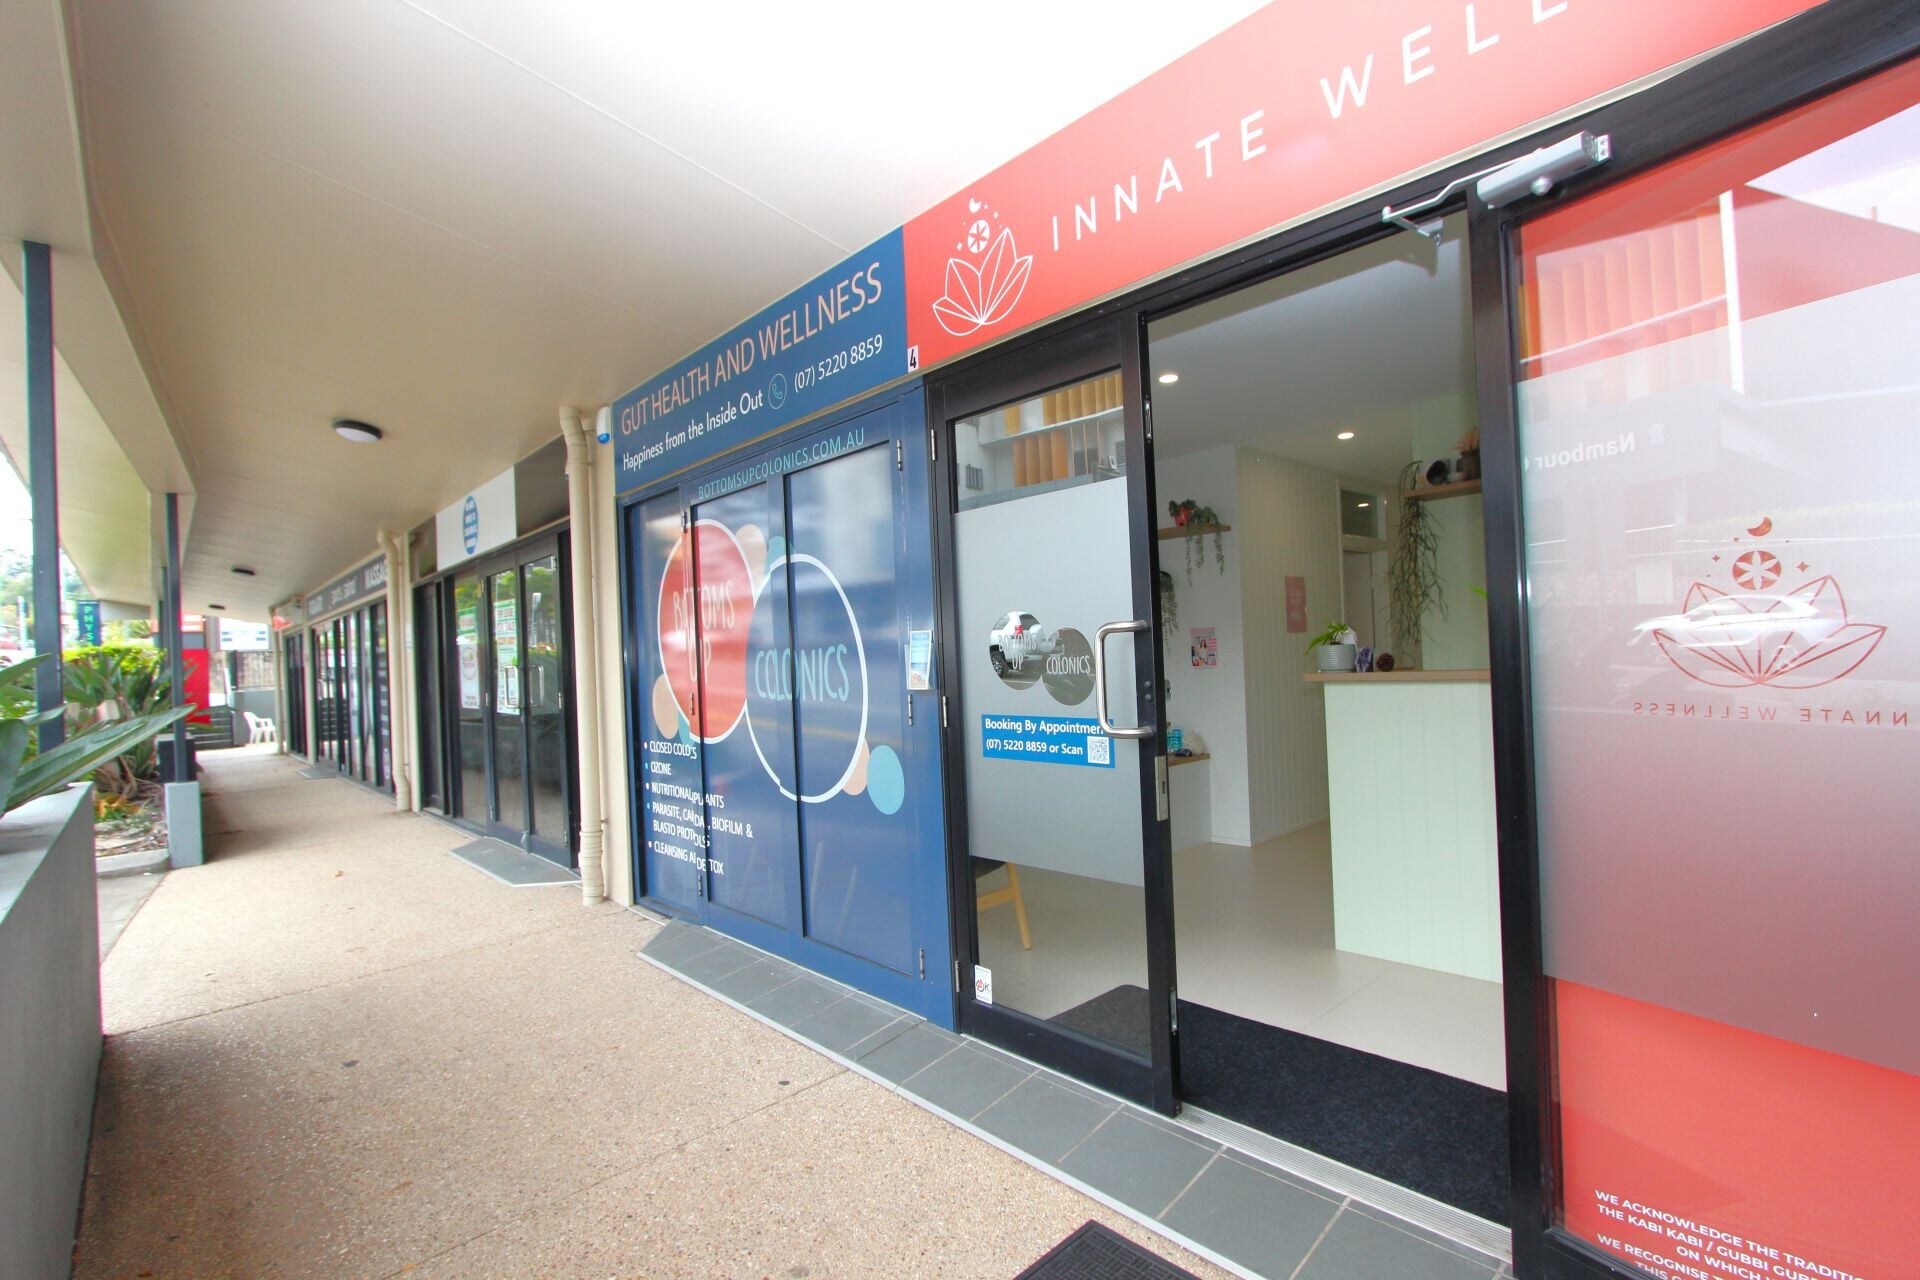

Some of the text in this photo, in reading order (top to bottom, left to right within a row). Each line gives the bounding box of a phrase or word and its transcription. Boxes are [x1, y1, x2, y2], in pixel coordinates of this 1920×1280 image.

[1052, 108, 1267, 252] INNATE
[621, 261, 882, 435] GUT HEALTH AND WELLNESS
[794, 334, 883, 393] (07) 5220 8859
[909, 349, 917, 369] 4
[622, 389, 763, 472] Happiness from the Inside Out
[698, 427, 865, 499] BOTTOMSUPCOLONICS.COM.AU
[84, 606, 95, 646] PHYS
[998, 633, 1037, 652] BOOMS
[754, 644, 850, 702] COLONICS
[1046, 655, 1091, 675] COLONICS
[985, 718, 1104, 735] Booking By Appointmen
[649, 740, 672, 754] CLOSED
[986, 738, 1083, 755] (07) 5220 8859 or Scan
[650, 761, 672, 776] OZONE
[652, 801, 682, 821] PARASITE,
[711, 816, 743, 836] BIOFILM
[745, 823, 754, 838] &
[653, 819, 676, 836] BLASTO
[654, 841, 688, 862] CLEANSING
[1595, 1189, 1865, 1280] WE ACKNOWLEDGE THE TRADITI
[1596, 1203, 1625, 1221] THE
[1628, 1214, 1663, 1235] KABI
[1666, 1227, 1703, 1249] KABI
[1716, 1245, 1769, 1271] GUBBI
[1596, 1233, 1709, 1280] WE RECOGNISE
[1635, 1260, 1668, 1280] THIS
[1676, 1245, 1761, 1280] ON WHICH
